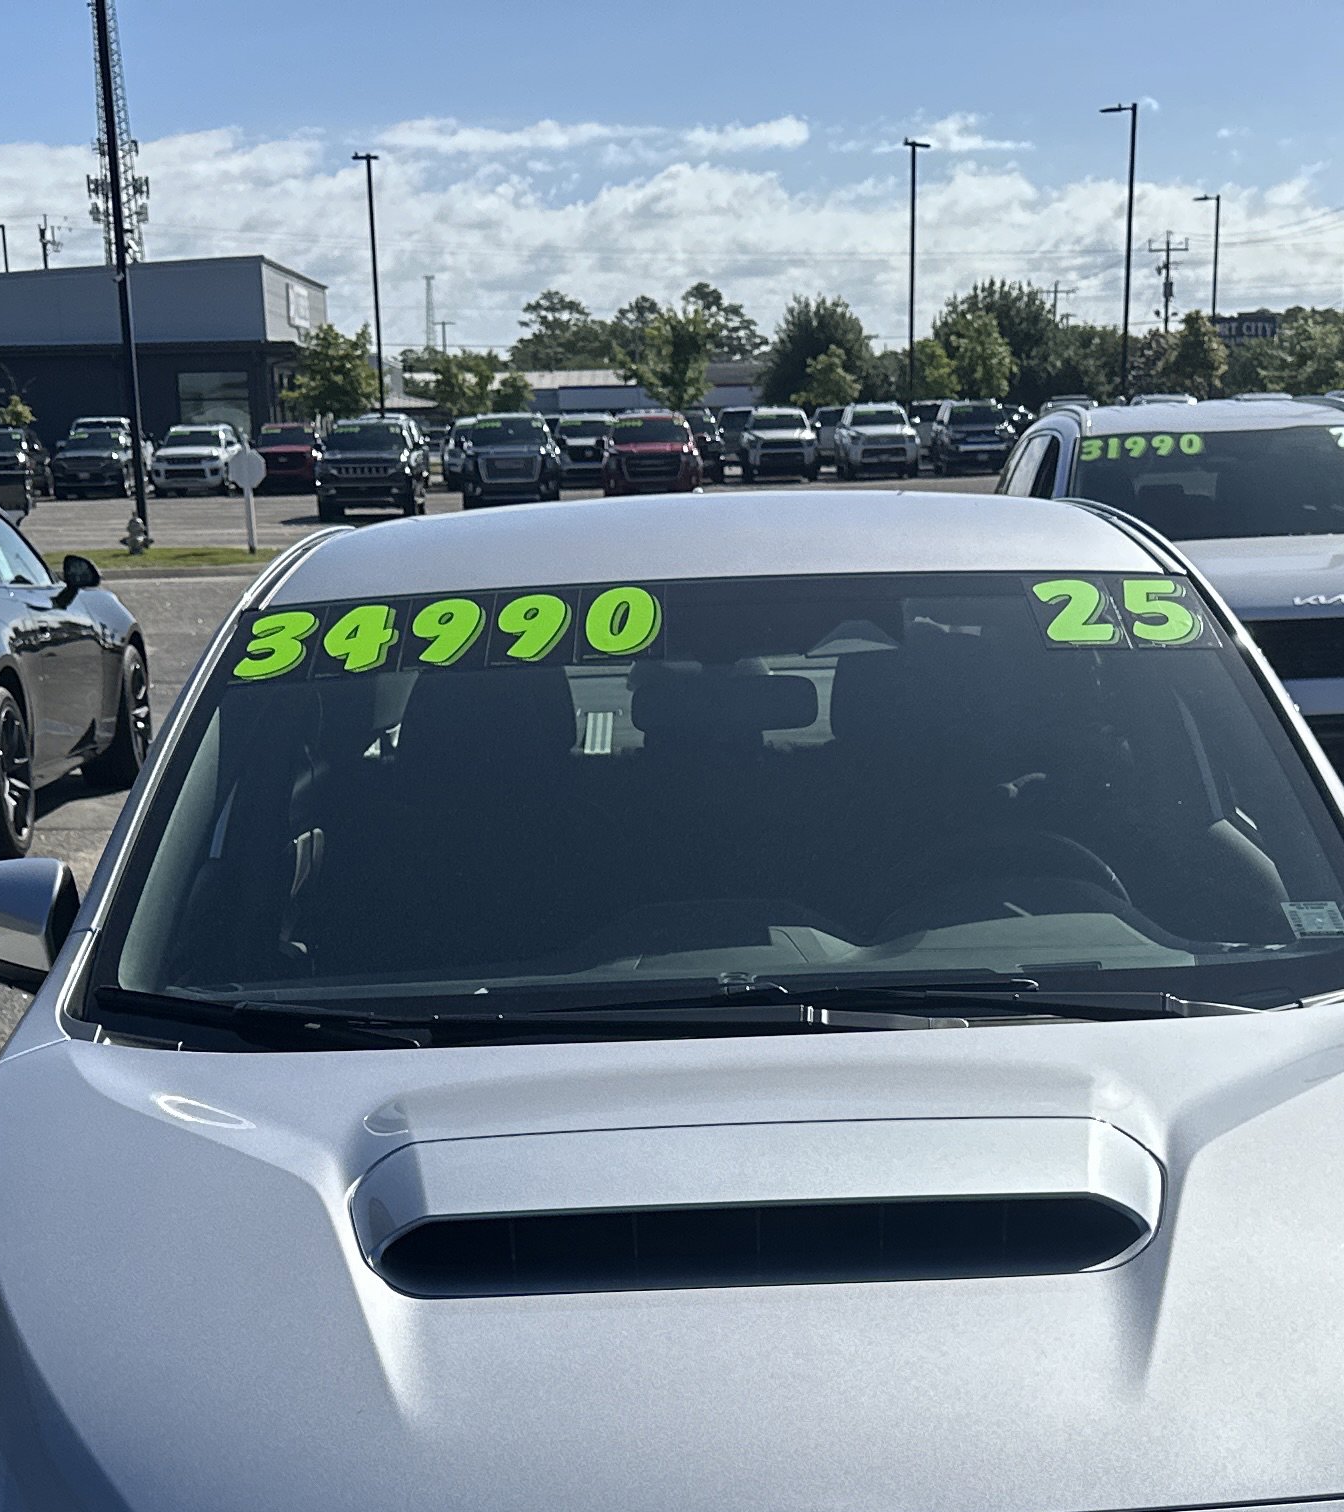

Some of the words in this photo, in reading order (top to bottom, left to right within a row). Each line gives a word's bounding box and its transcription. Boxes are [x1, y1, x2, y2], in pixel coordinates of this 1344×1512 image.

[1079, 433, 1204, 461] 31990
[232, 586, 662, 681] 34990
[1032, 579, 1204, 645] 25
